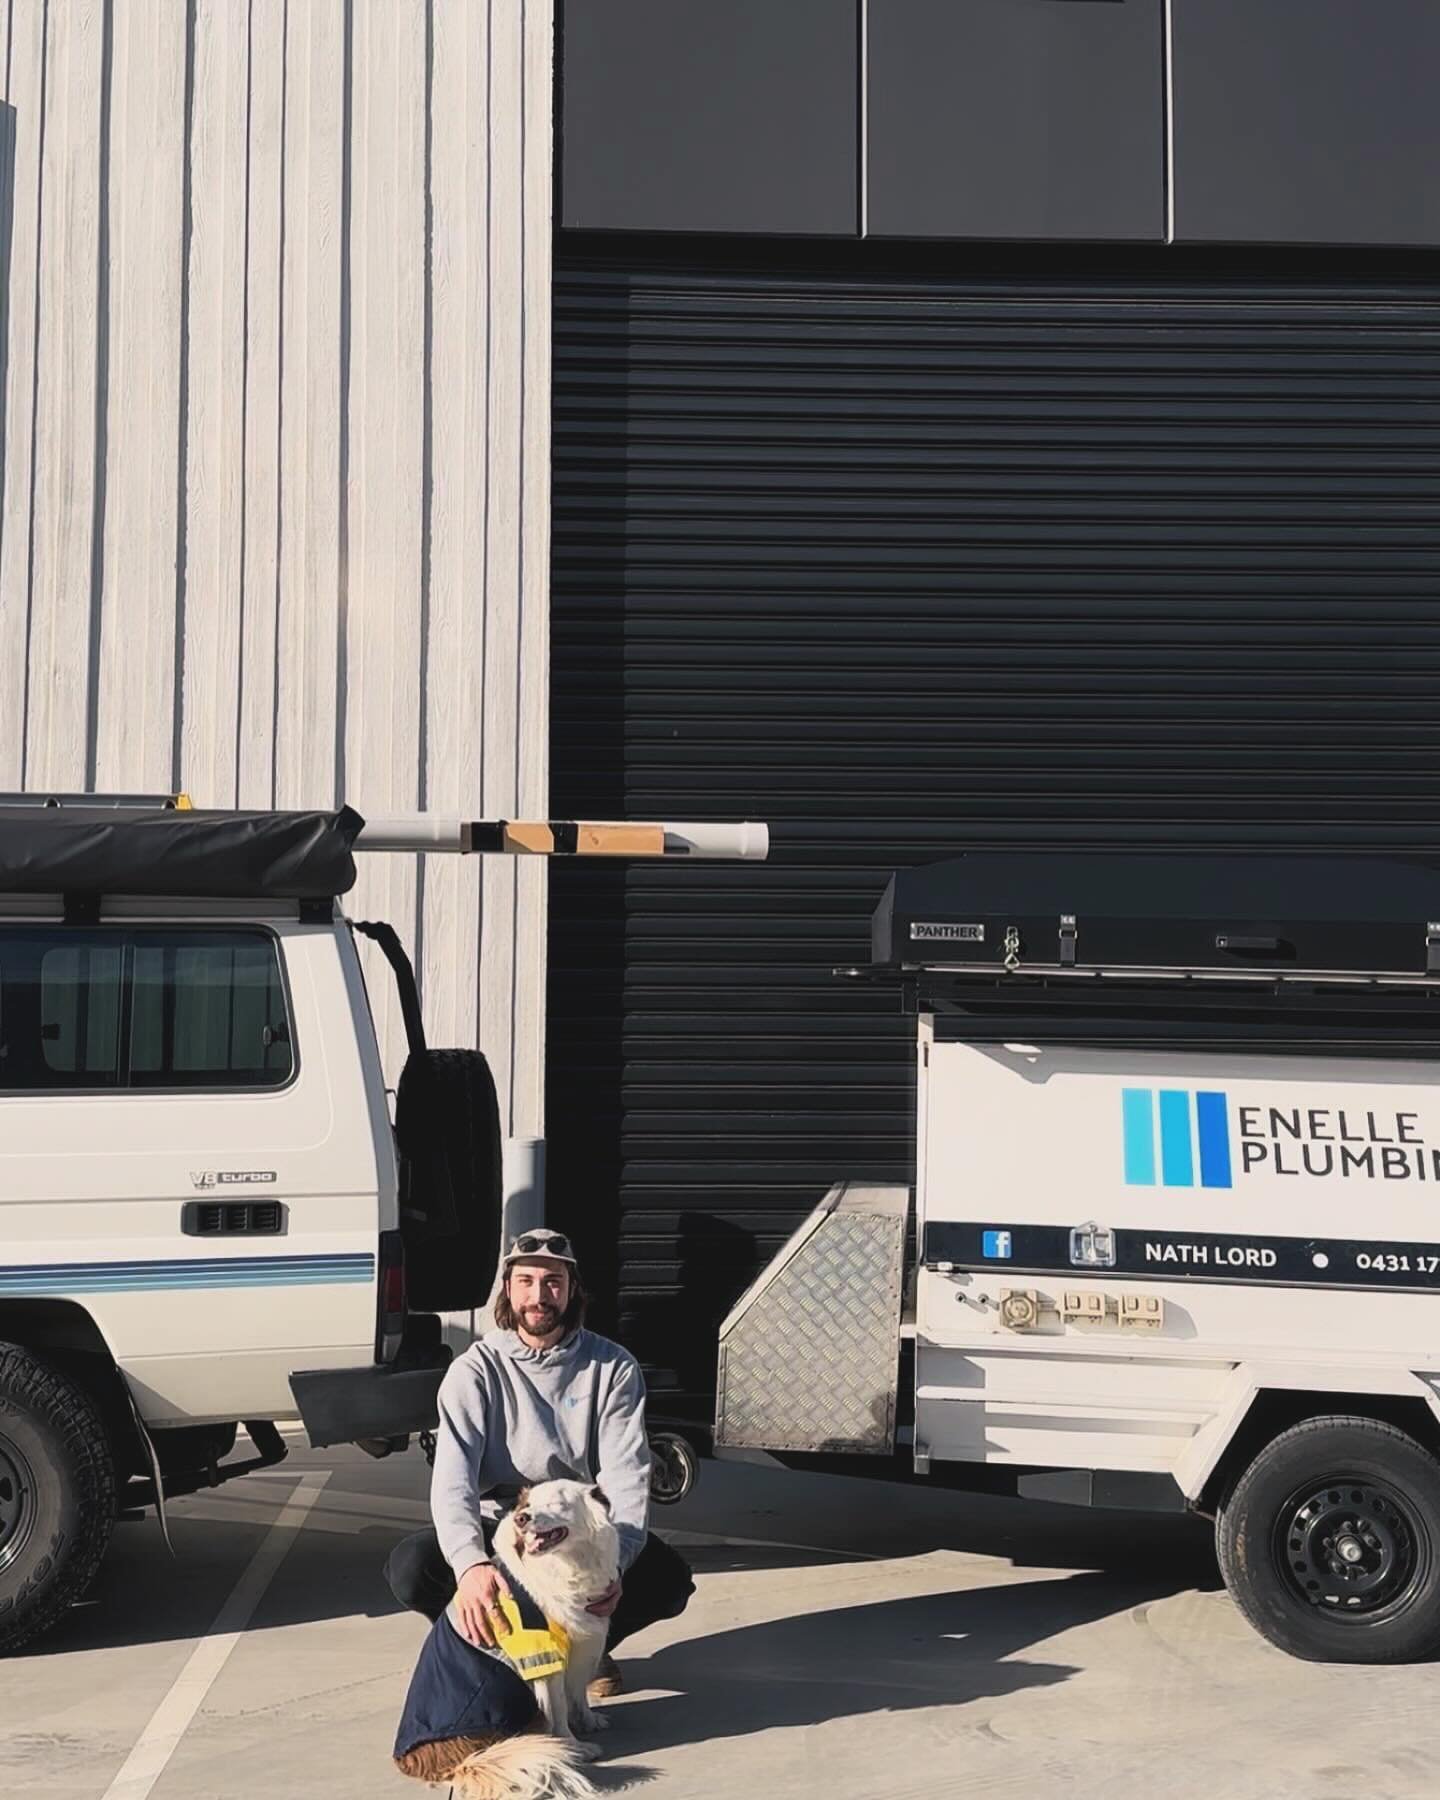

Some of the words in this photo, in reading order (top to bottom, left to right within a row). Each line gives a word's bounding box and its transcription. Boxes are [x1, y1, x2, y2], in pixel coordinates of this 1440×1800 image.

[915, 924, 978, 938] PANTHER
[1239, 1106, 1425, 1144] ENELLE
[1242, 1141, 1440, 1181] PLUMBI
[189, 1170, 217, 1185] V8
[1145, 1243, 1208, 1263] NATH
[1215, 1246, 1277, 1267] LORD
[1356, 1253, 1411, 1272] 0431
[1416, 1256, 1440, 1273] 17
